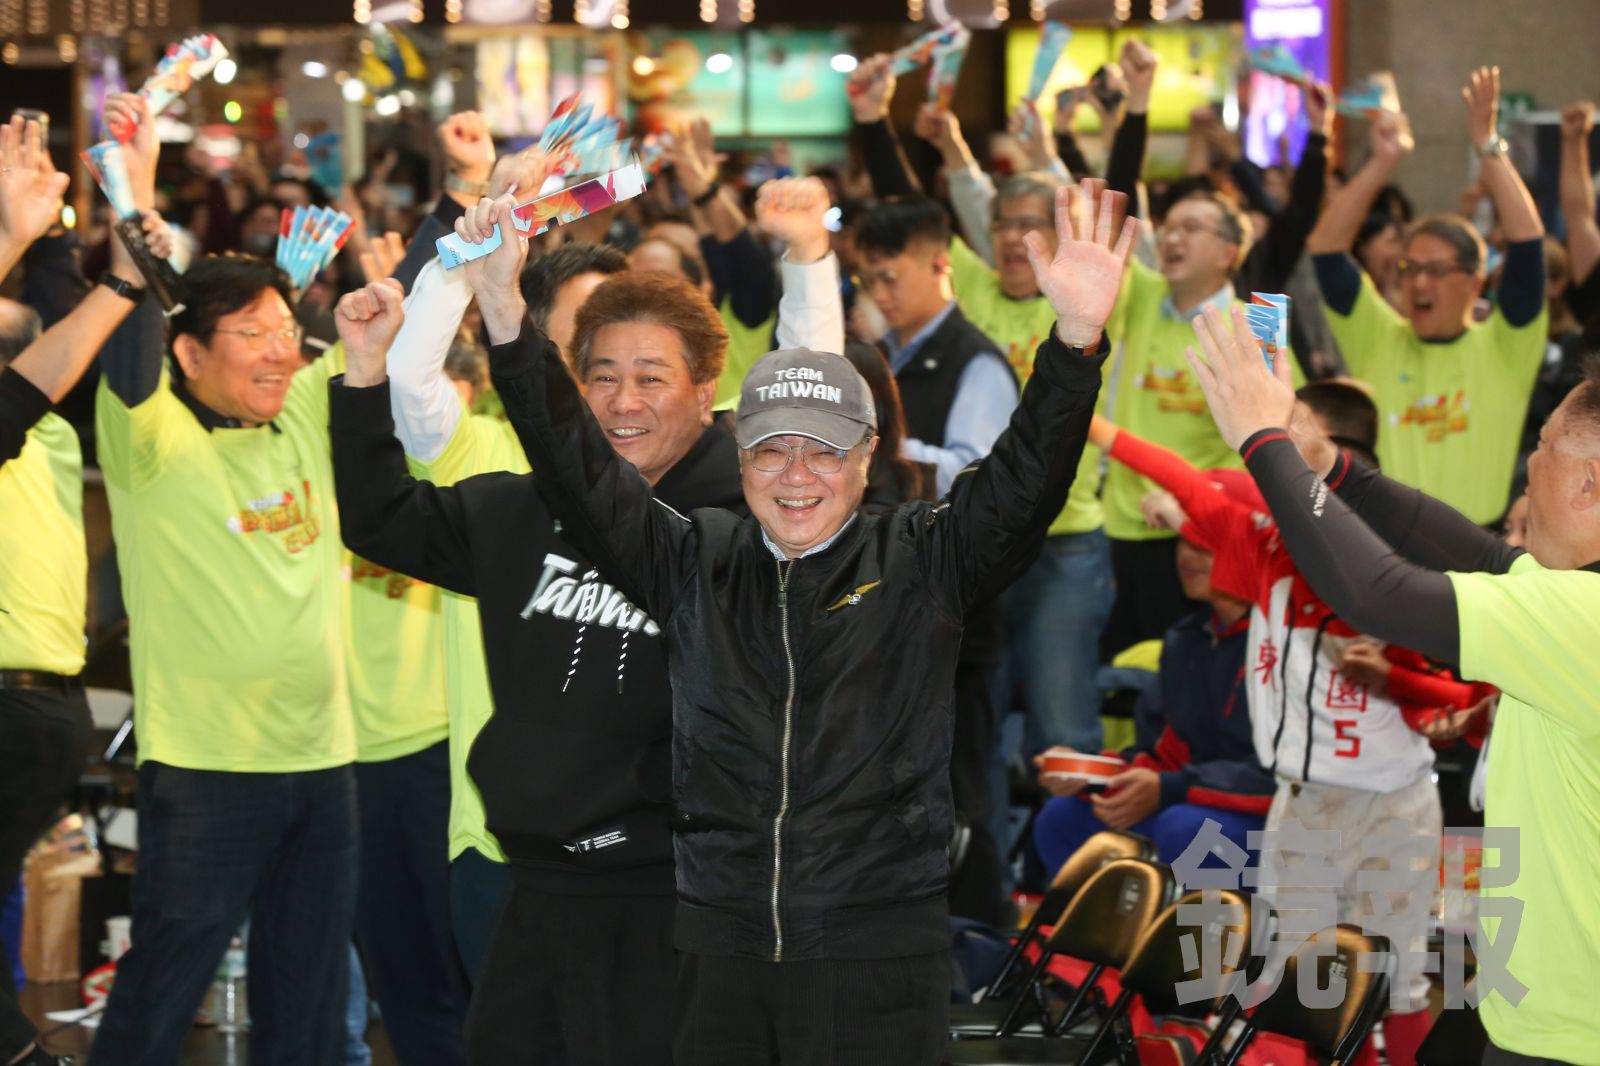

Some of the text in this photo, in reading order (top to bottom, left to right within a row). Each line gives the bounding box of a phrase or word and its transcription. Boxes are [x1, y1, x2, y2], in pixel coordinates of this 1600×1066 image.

[774, 367, 824, 382] TEAM
[755, 380, 842, 404] TAIWAN
[1333, 719, 1361, 759] 5
